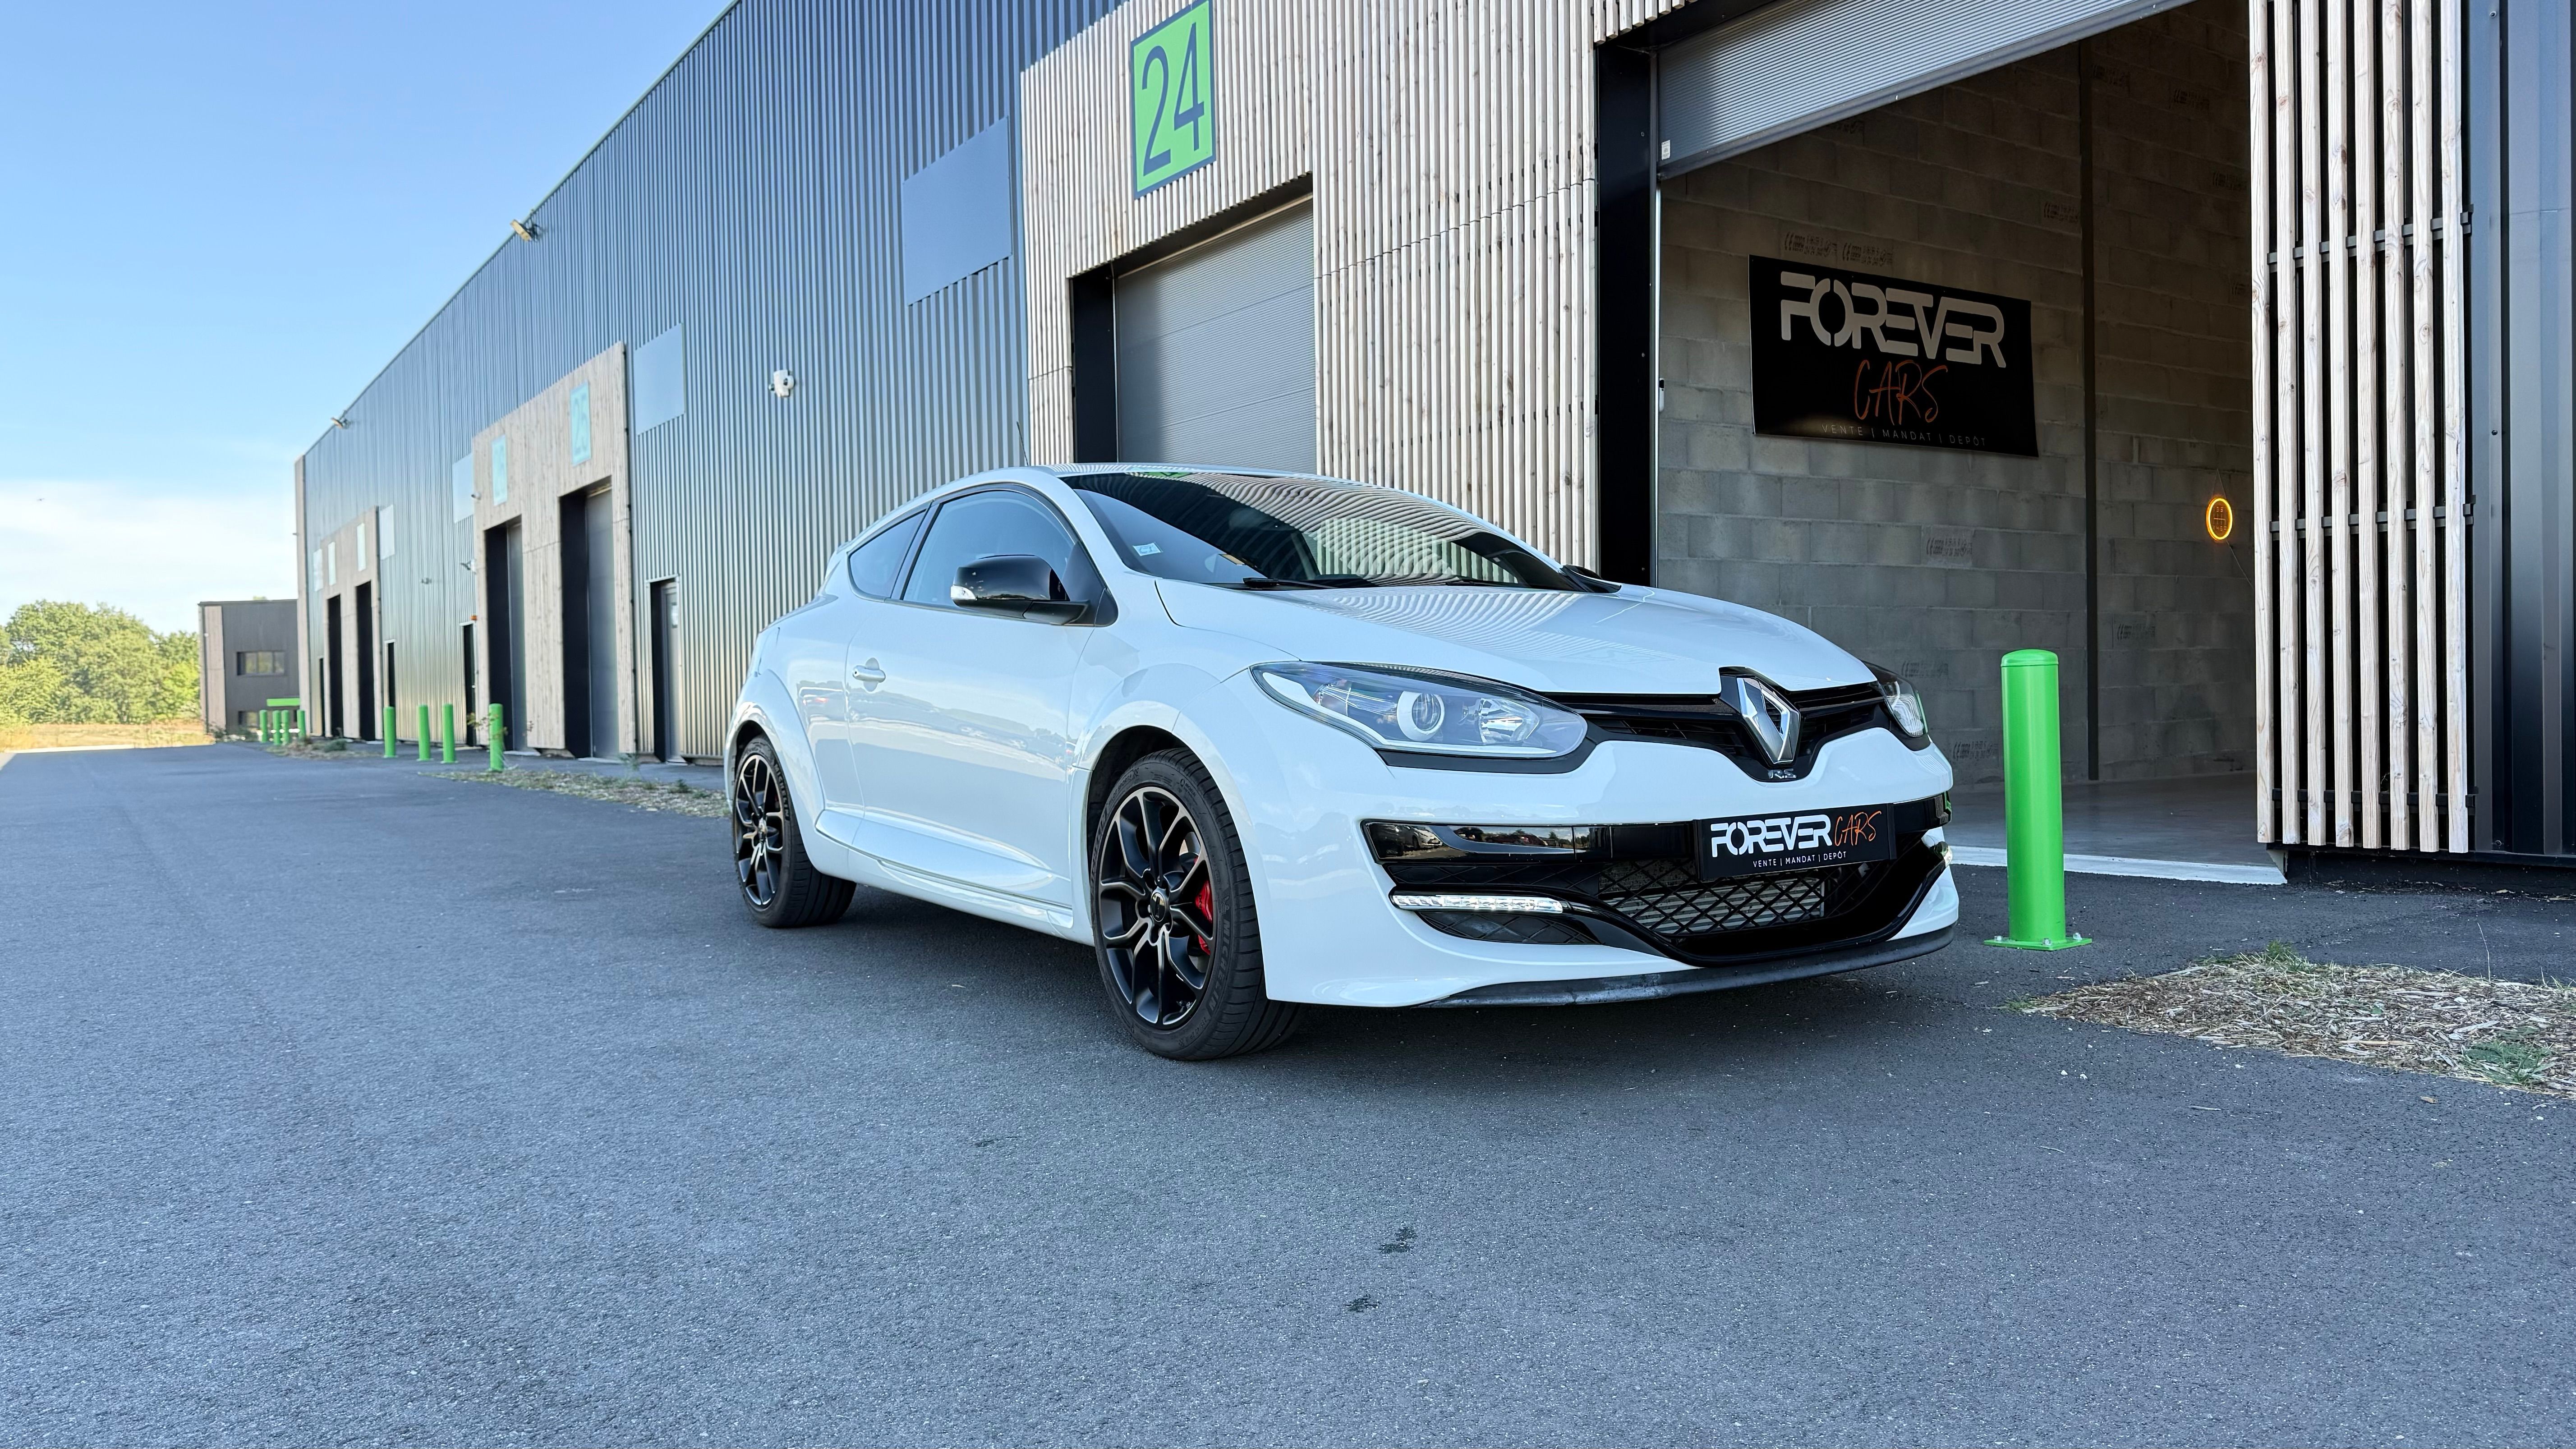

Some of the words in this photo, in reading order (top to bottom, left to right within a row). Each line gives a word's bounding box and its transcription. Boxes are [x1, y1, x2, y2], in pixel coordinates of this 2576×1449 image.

[1142, 22, 1205, 177] 24
[1780, 271, 2006, 368] FOREVER
[1854, 359, 1948, 425] CARS
[1822, 424, 1863, 436] VENTE
[1883, 429, 1931, 442] MANDAT
[773, 763, 789, 817] MICHELIN
[1711, 814, 1832, 857] FOREVER
[1834, 810, 1881, 846] CARS
[1753, 858, 1777, 868] VENTE
[1785, 855, 1815, 865] MANDAT
[1823, 851, 1847, 861] DEPÔT
[1208, 919, 1230, 1012] MICHELIN
